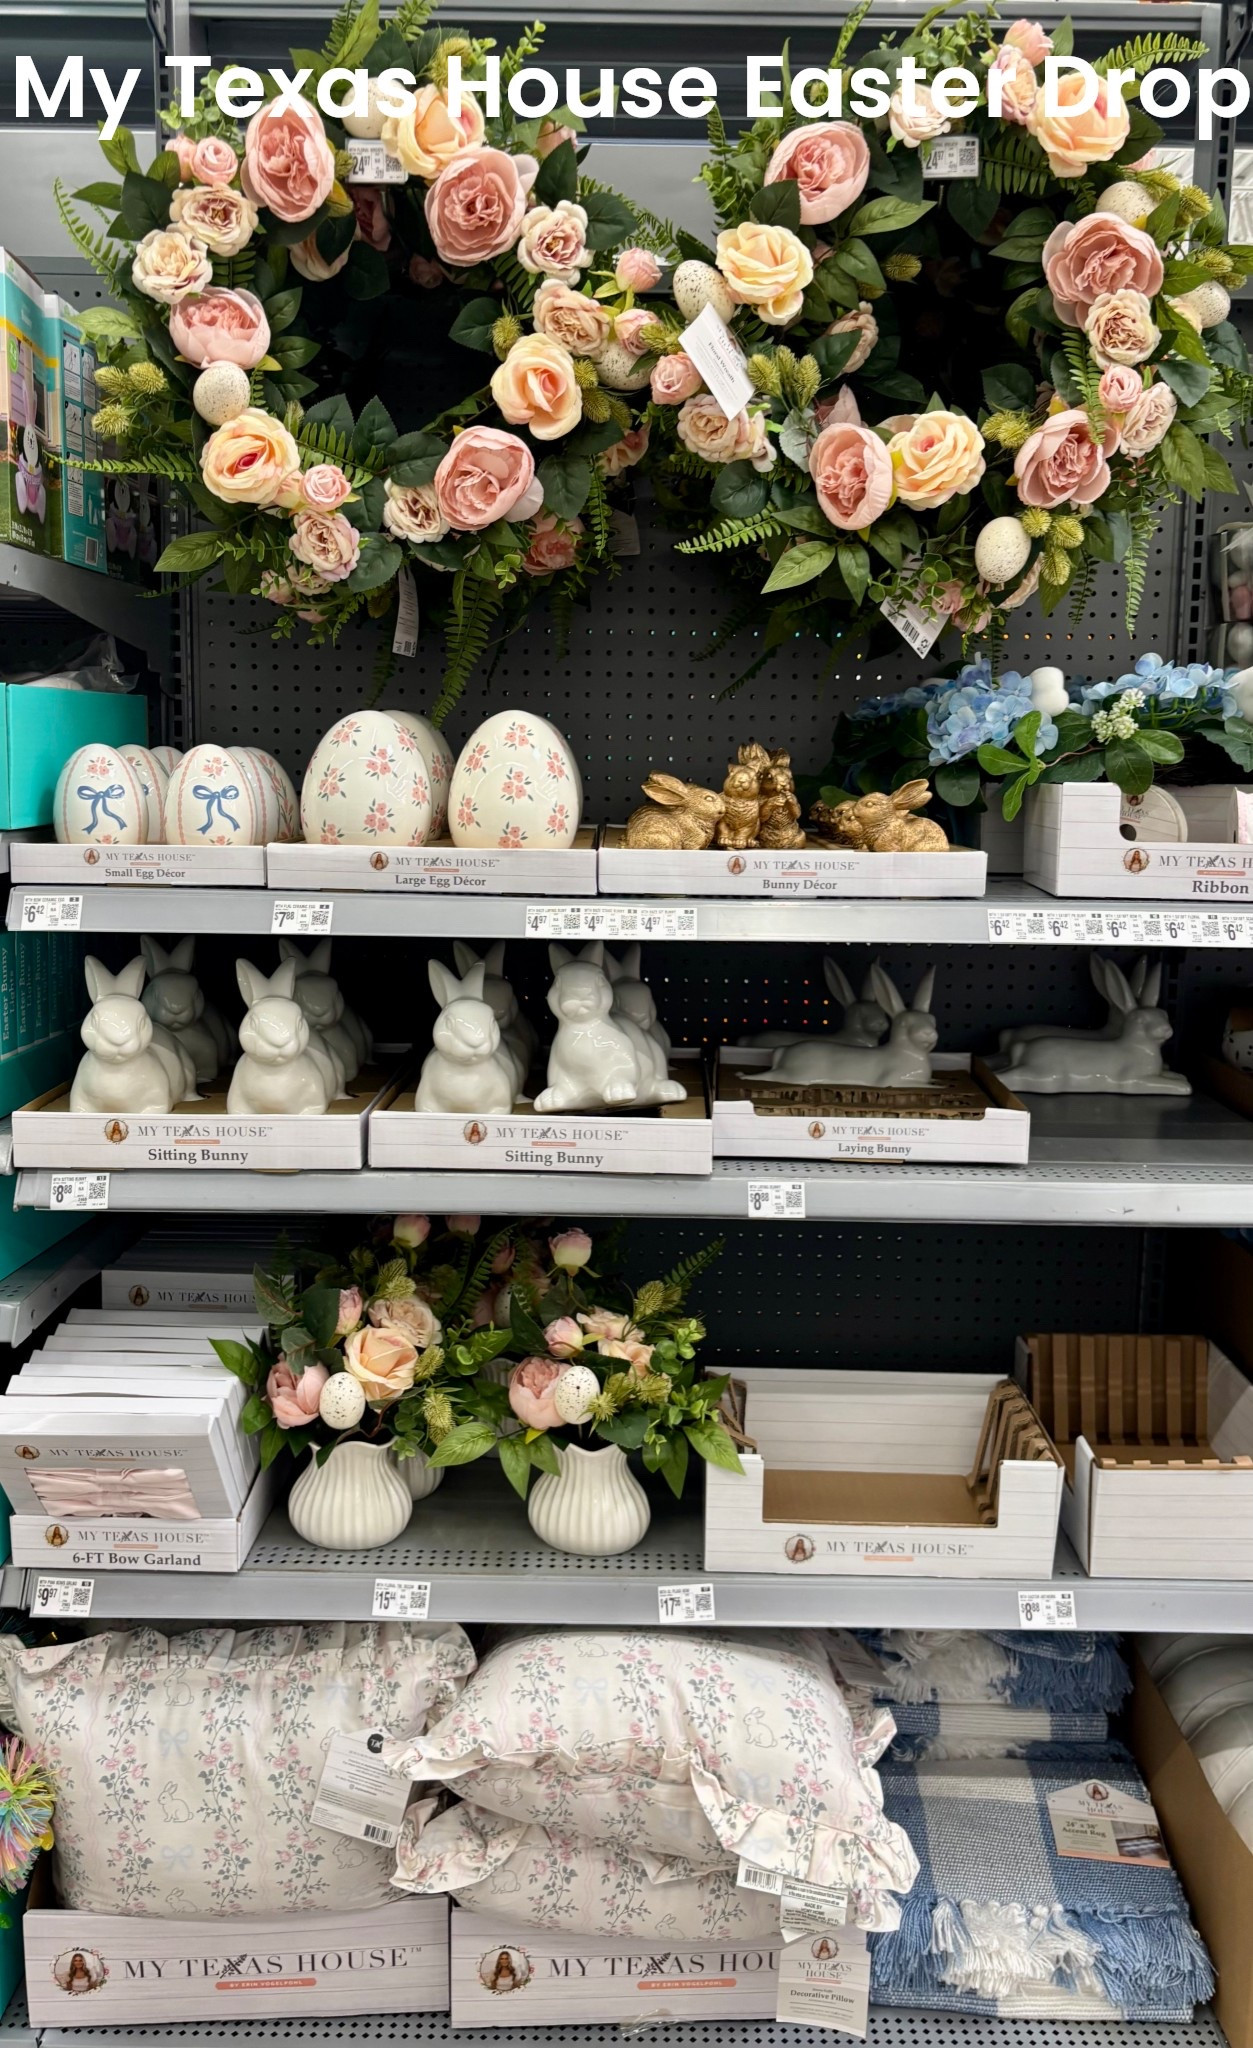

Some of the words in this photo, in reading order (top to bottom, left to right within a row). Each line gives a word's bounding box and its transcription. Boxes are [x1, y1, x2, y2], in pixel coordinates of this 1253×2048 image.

[105, 853, 120, 861] MY
[122, 852, 154, 861] TEXAS
[394, 857, 412, 866] MY
[415, 856, 452, 867] TEXAS
[1159, 855, 1182, 867] MY
[1186, 855, 1236, 869] TEXAS
[753, 861, 770, 870] MY
[773, 860, 811, 870] TEXAS
[105, 868, 133, 877] Small
[135, 869, 155, 880] Egg
[156, 868, 186, 878] Décor
[395, 875, 426, 887] Large
[429, 875, 451, 888] Egg
[453, 875, 487, 886] Décor
[762, 880, 800, 892] Bunny
[803, 880, 838, 890] Décor
[1192, 880, 1249, 894] Ribbon
[137, 1125, 159, 1137] MY
[162, 1125, 211, 1138] TEXAS
[496, 1127, 517, 1138] MY
[520, 1126, 567, 1140] TEXAS
[832, 1126, 848, 1135] MY
[849, 1126, 884, 1136] TEXAS
[838, 1143, 874, 1155] Laying
[876, 1144, 912, 1156] Bunny
[148, 1148, 198, 1165] Sitting
[201, 1149, 249, 1165] Bunny
[505, 1150, 553, 1167] Sitting
[556, 1151, 604, 1168] Bunny
[158, 1291, 175, 1301] MY
[179, 1291, 220, 1303] TEXAS
[49, 1449, 70, 1457] MY
[74, 1449, 124, 1457] TEXAS
[78, 1531, 98, 1541] MY
[102, 1530, 149, 1543] TEXAS
[826, 1540, 848, 1552] MY
[853, 1540, 905, 1554] TEXAS
[72, 1552, 105, 1564] 6-FT
[108, 1552, 140, 1564] Bow
[144, 1553, 202, 1566] Garland
[1062, 1827, 1088, 1835] Accent
[1089, 1830, 1107, 1838] Rug
[123, 1959, 168, 1979] MY
[180, 1953, 284, 1979] TEXAS
[547, 1957, 593, 1978] MY
[604, 1952, 705, 1978] TEXAS
[798, 1962, 813, 1970] MY
[816, 1962, 852, 1972] TEXAS
[790, 1989, 830, 2000] Decorative
[831, 1993, 855, 2004] Pillow
